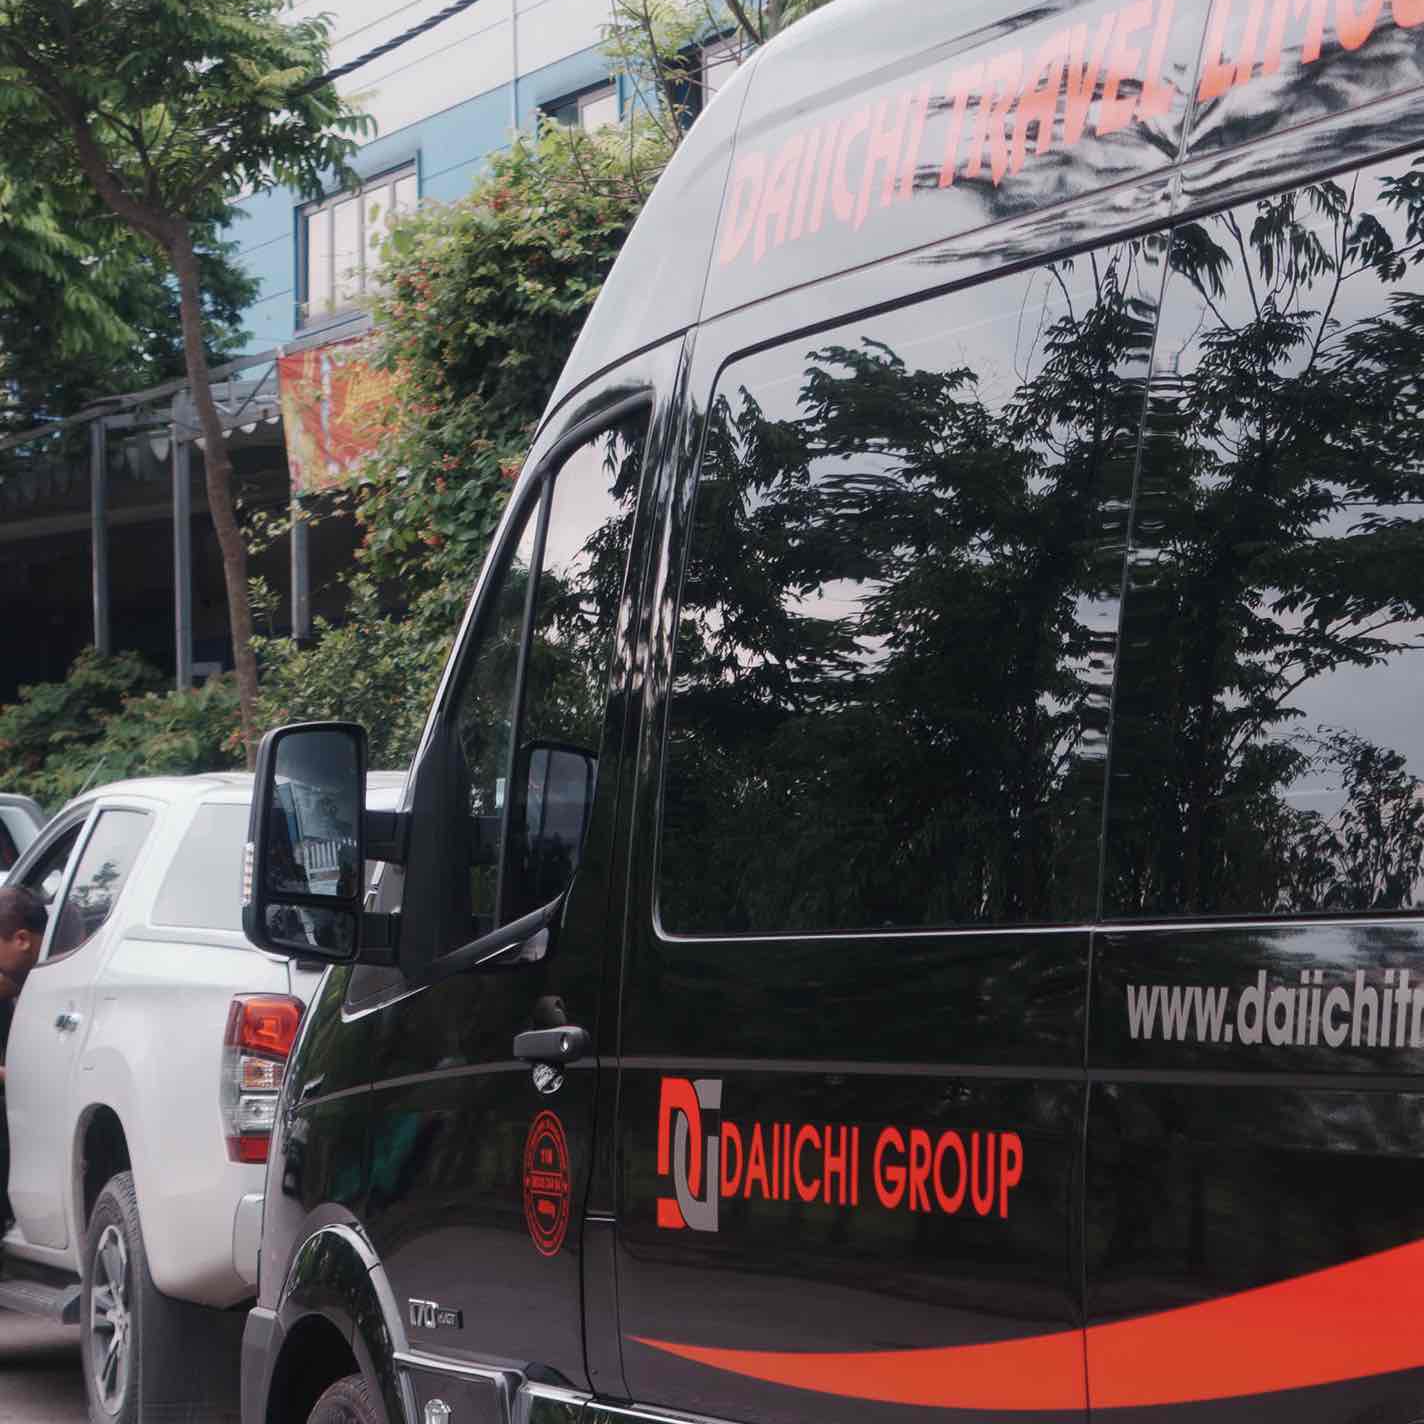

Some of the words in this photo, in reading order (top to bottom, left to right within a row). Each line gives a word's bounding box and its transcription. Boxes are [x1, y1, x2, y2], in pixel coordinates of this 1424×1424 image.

[719, 79, 931, 266] DAIICHI
[720, 1120, 860, 1207] DAIICHI
[873, 1125, 1024, 1220] GROUP
